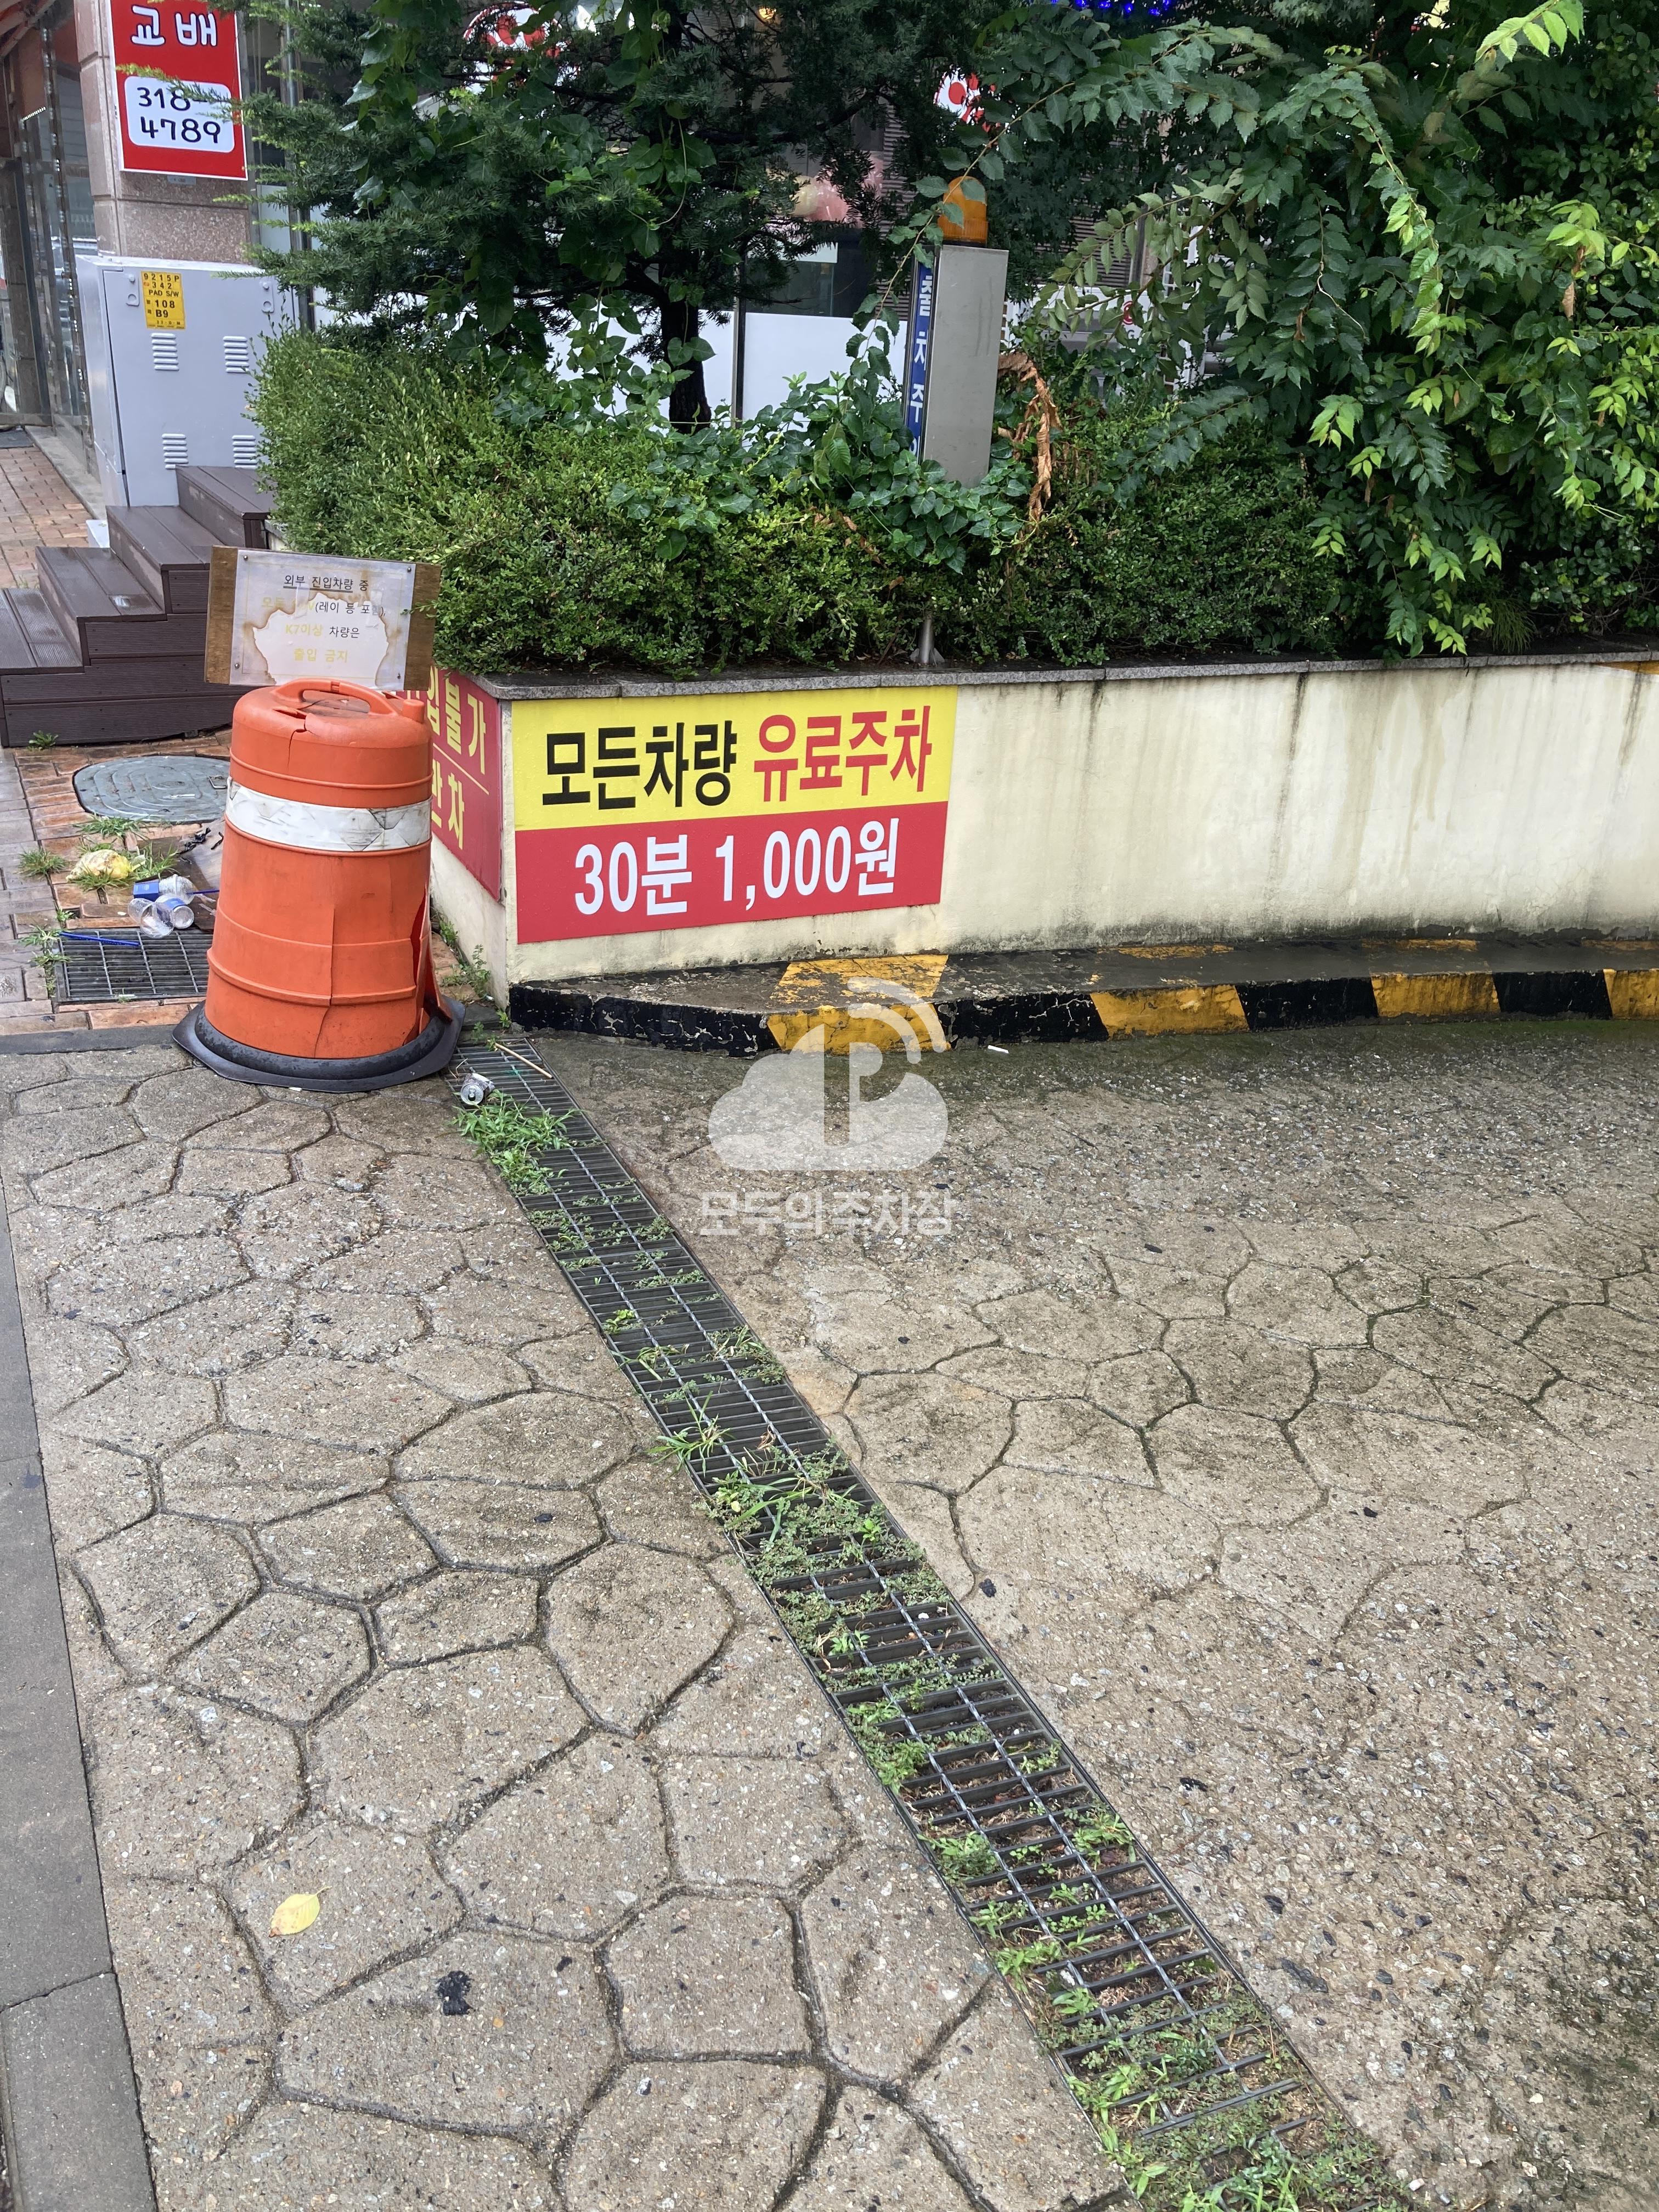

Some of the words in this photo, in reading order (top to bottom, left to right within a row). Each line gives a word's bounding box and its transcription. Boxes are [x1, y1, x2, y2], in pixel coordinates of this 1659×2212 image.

[130, 4, 218, 47] 교배
[140, 116, 221, 144] 4789
[152, 281, 172, 290] 342
[155, 300, 175, 308] 108
[156, 309, 168, 318] B9
[284, 574, 305, 587] 외부
[311, 576, 354, 591] 진입차량
[359, 580, 369, 592] 중
[345, 603, 355, 614] 등
[285, 624, 323, 636] K7이상
[329, 626, 360, 639] 차량은
[294, 648, 318, 662] 출입
[324, 649, 348, 663] 금지
[543, 720, 737, 810] 모든차량
[753, 705, 933, 803] 유료주차
[574, 834, 692, 916] 30분
[715, 817, 900, 911] 1,000원
